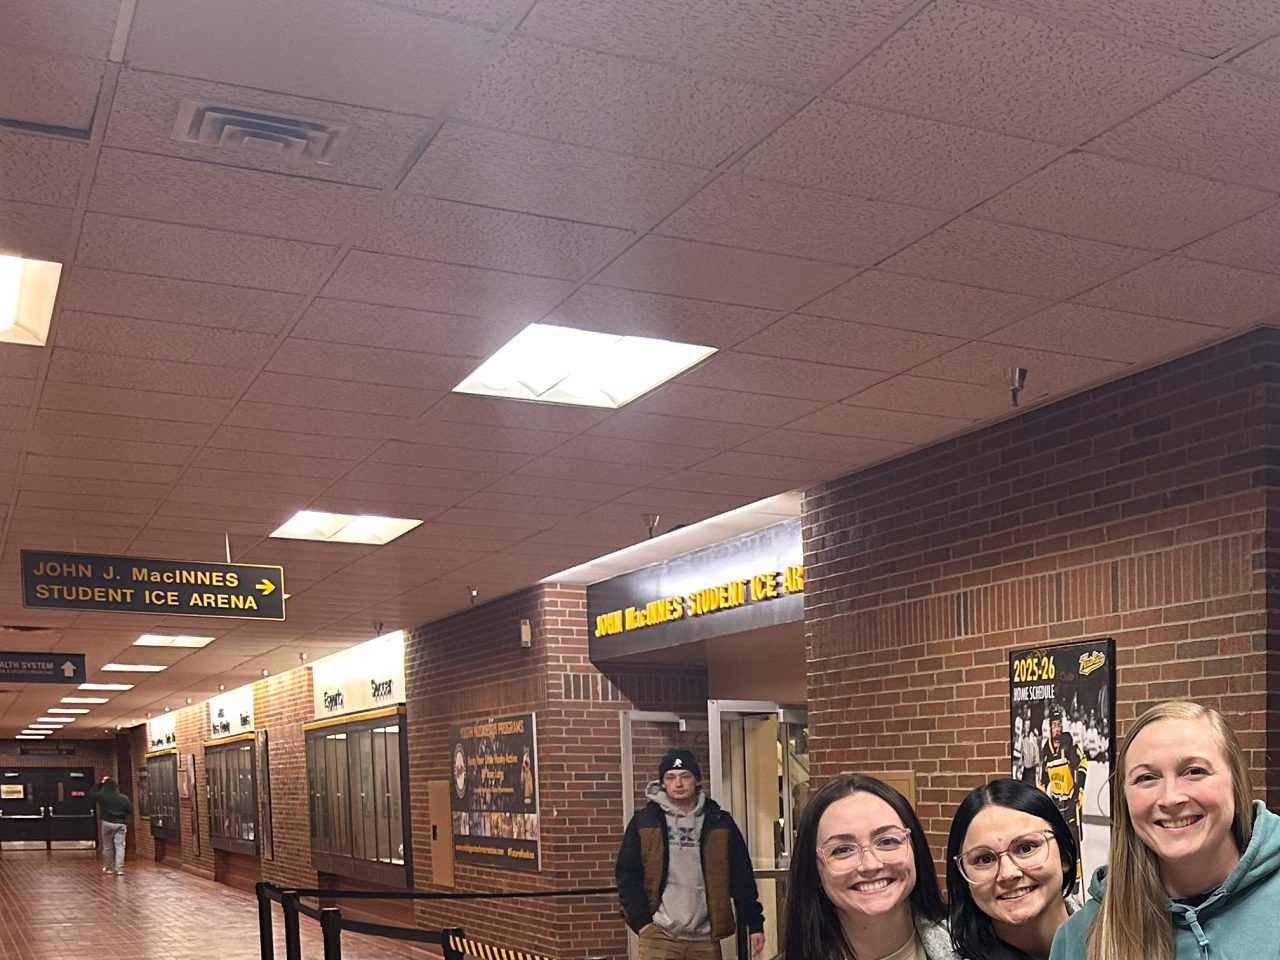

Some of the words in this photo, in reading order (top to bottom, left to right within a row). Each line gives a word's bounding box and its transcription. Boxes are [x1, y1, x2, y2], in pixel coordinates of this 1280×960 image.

[33, 561, 92, 578] JOHN
[103, 565, 121, 580] J.
[132, 567, 239, 587] MacINNES
[35, 583, 135, 603] STUDENT
[144, 590, 179, 606] ICE
[189, 593, 258, 610] ARENA
[595, 610, 623, 638] JOHN
[624, 597, 684, 631] MacINNES
[687, 579, 747, 617] STUDENT
[750, 572, 777, 601] ICE
[21, 661, 54, 670] SYSTEM
[1013, 656, 1056, 683] 2025-26
[1013, 686, 1029, 702] HOME
[1029, 683, 1056, 700] SCHEDULE
